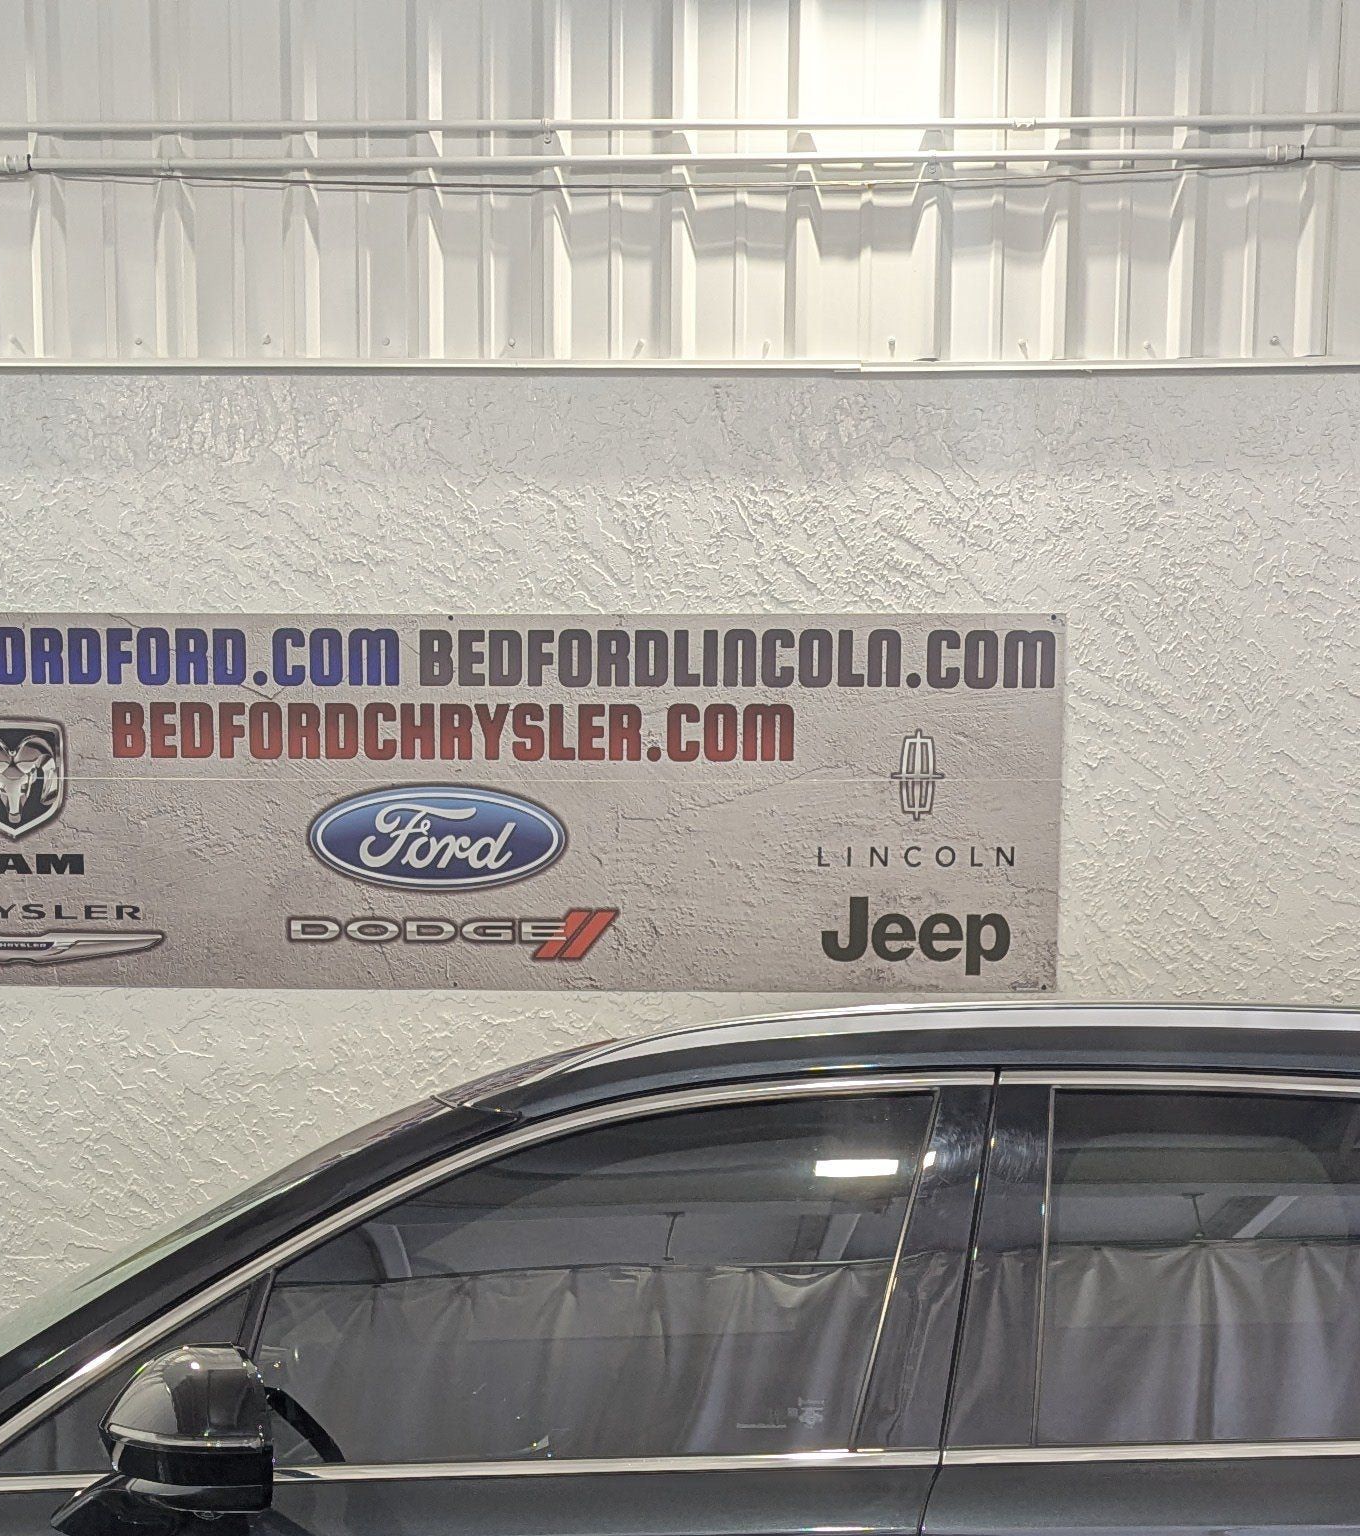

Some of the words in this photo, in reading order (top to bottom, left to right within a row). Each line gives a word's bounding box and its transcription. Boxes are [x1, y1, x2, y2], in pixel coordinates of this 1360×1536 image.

[418, 628, 1054, 690] BEDFORDLINCOLN.COM
[112, 701, 795, 763] BEDFORDCHRYSLER.COM
[359, 803, 517, 870] Ford
[816, 846, 1016, 868] LINCOLN
[290, 919, 568, 943] DODGE
[822, 896, 1012, 976] Jeep
